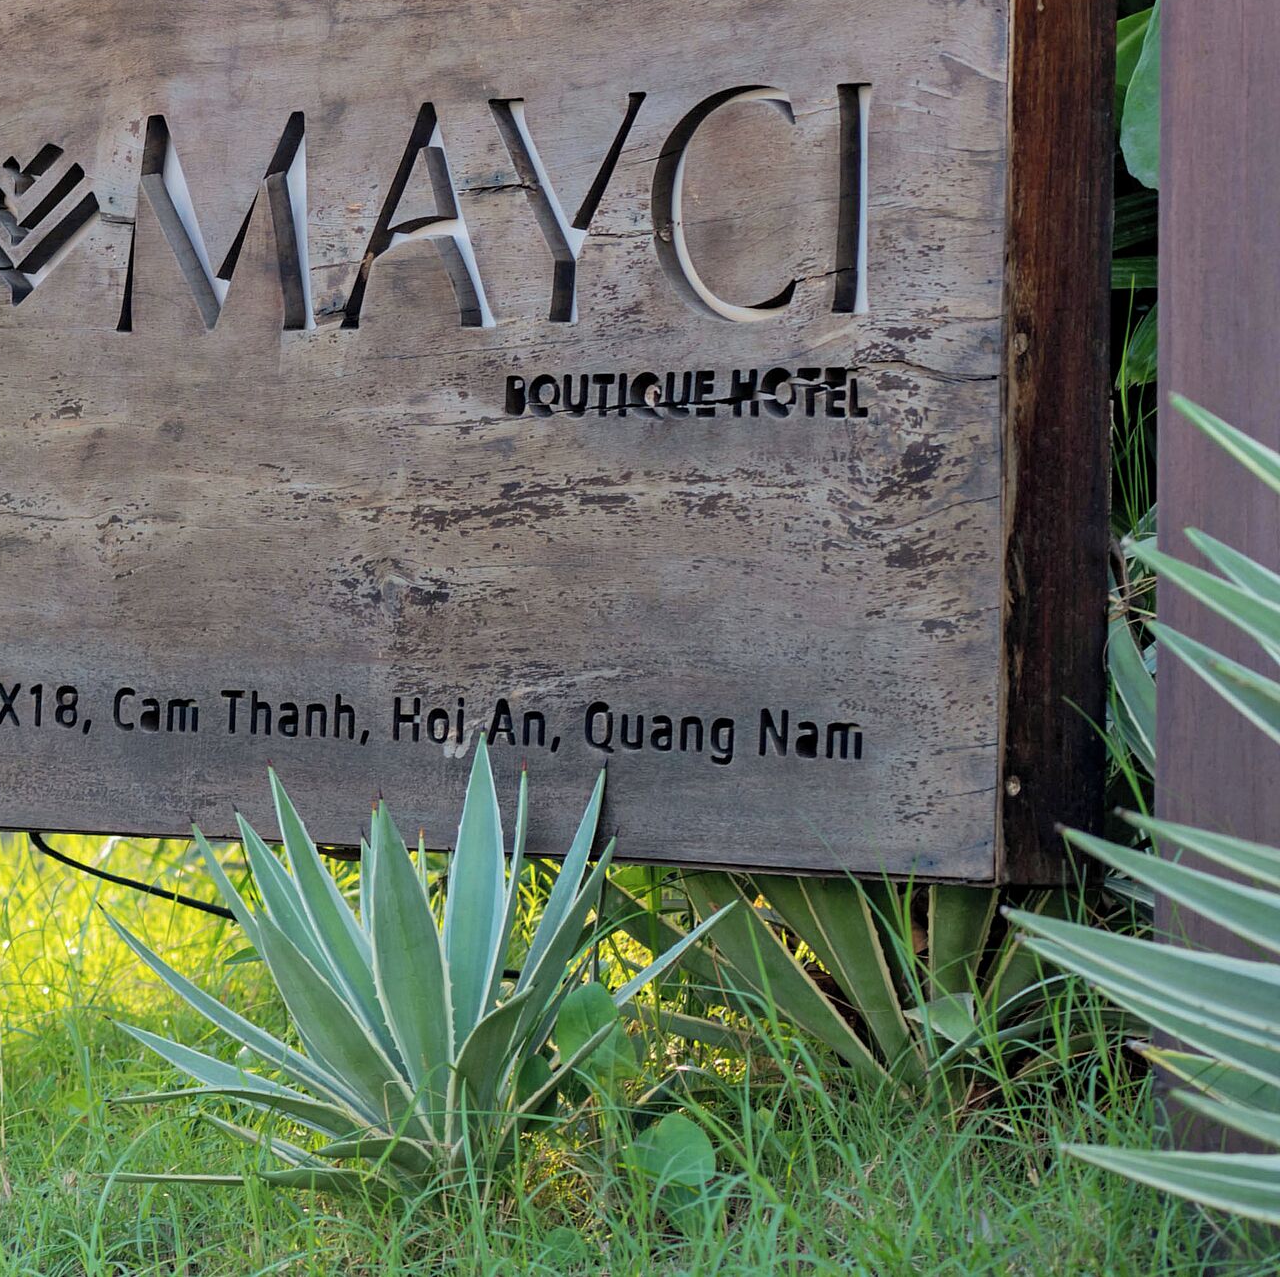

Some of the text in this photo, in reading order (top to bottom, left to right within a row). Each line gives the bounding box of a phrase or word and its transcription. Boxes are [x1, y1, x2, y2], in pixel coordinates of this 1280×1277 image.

[115, 82, 873, 332] MAYCI
[505, 366, 869, 420] BOUTIQUE HOTEL
[113, 686, 200, 733] Cam
[220, 689, 371, 747] Thanh,
[393, 697, 466, 745] Hoi
[485, 697, 561, 754] An,
[584, 700, 735, 766] Quang
[758, 707, 863, 761] Nam
